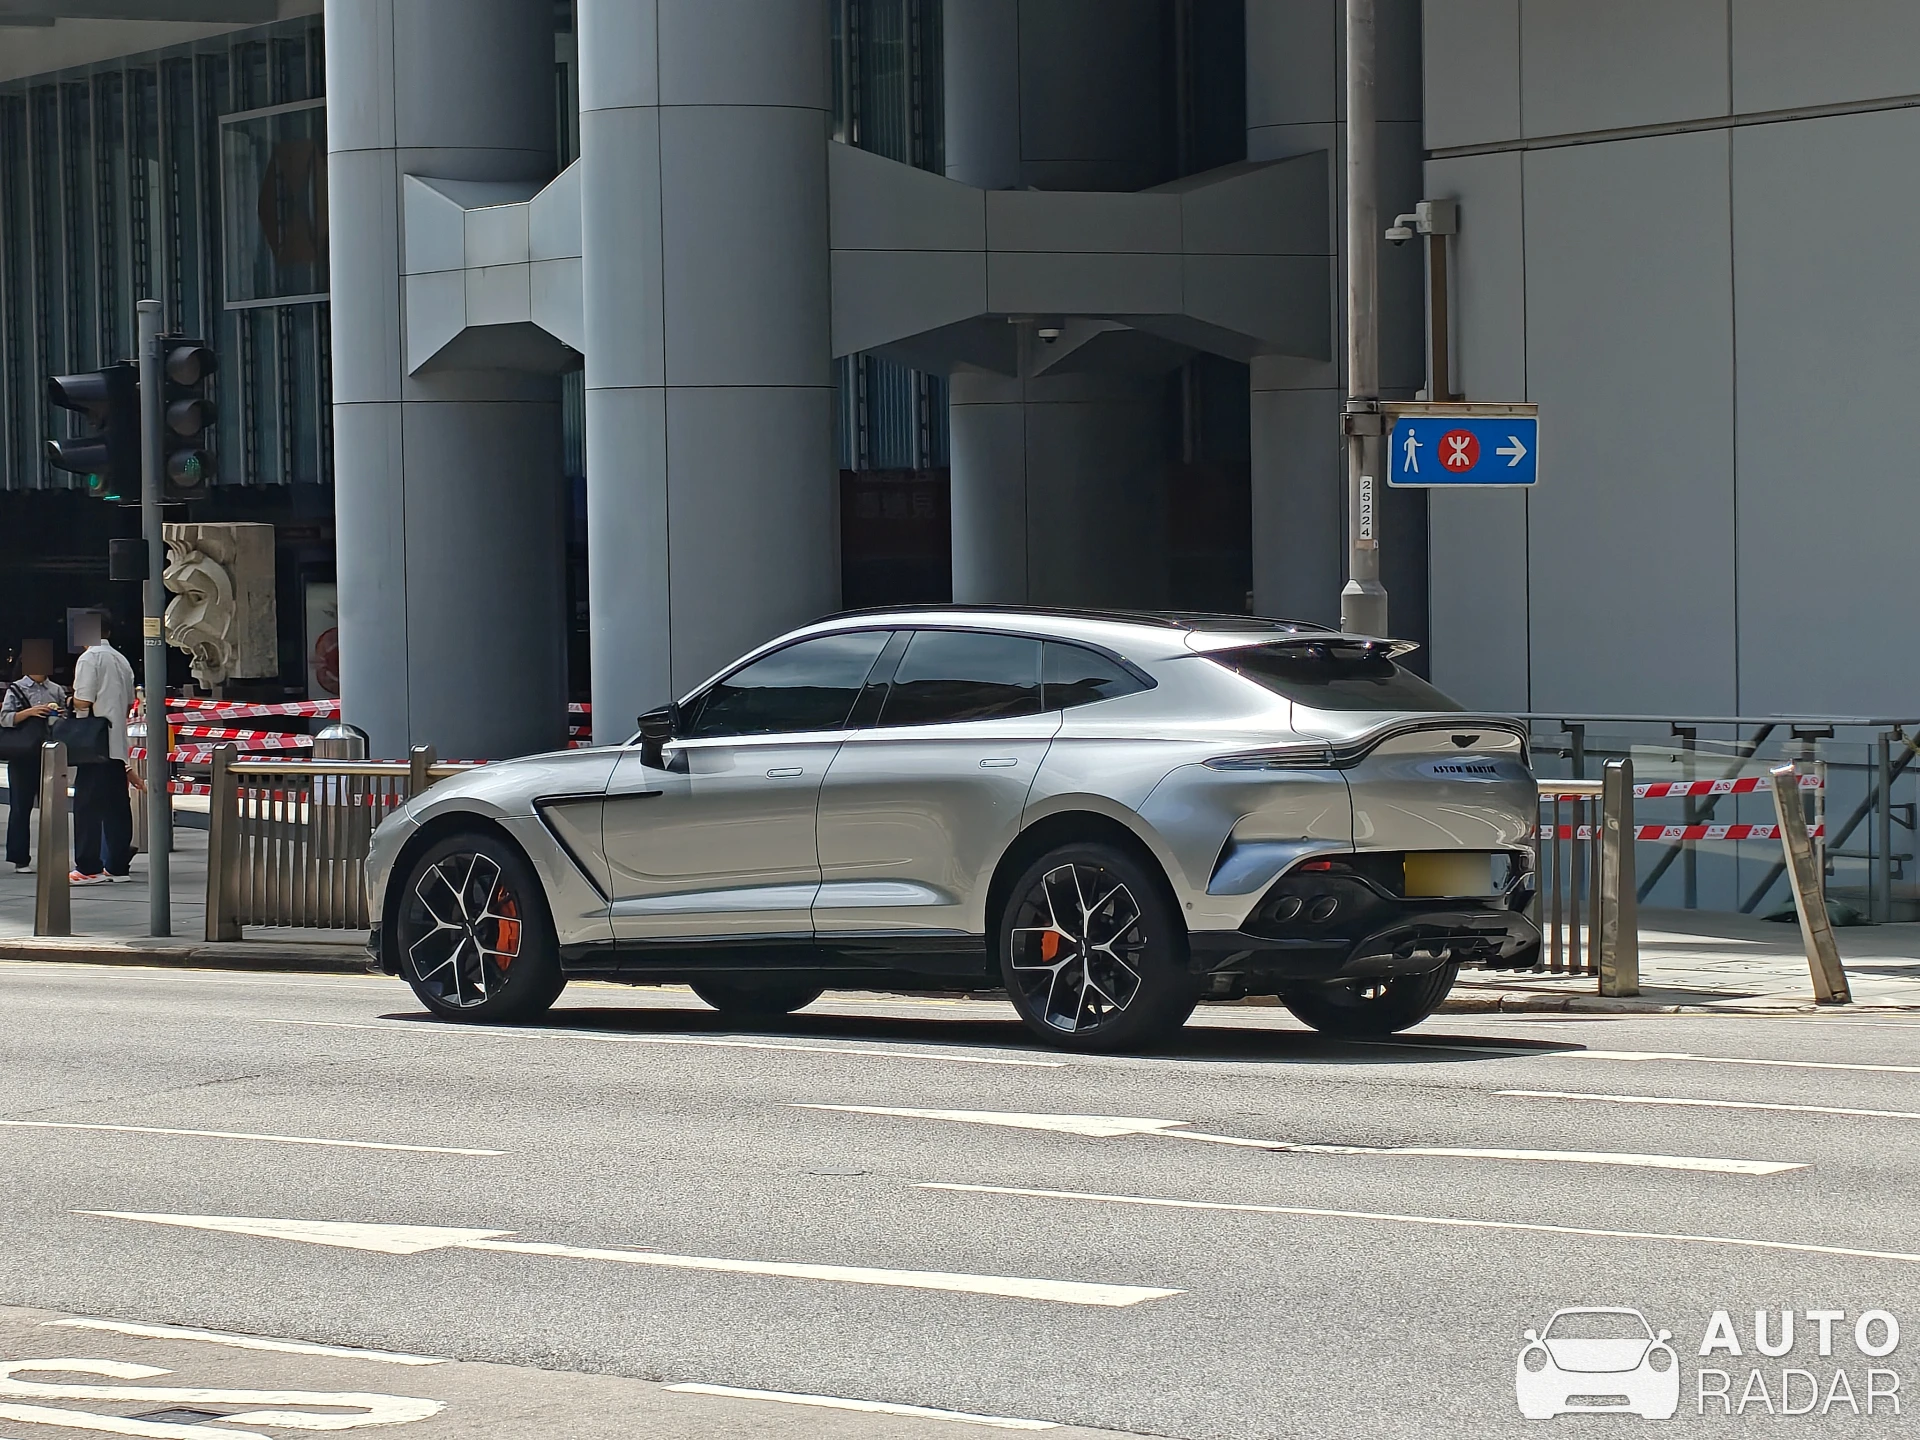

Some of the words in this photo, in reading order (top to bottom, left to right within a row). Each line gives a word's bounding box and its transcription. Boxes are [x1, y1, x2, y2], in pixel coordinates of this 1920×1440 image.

[1361, 480, 1371, 537] 25224
[1433, 765, 1463, 774] ASTON
[1465, 765, 1496, 774] MARTIN
